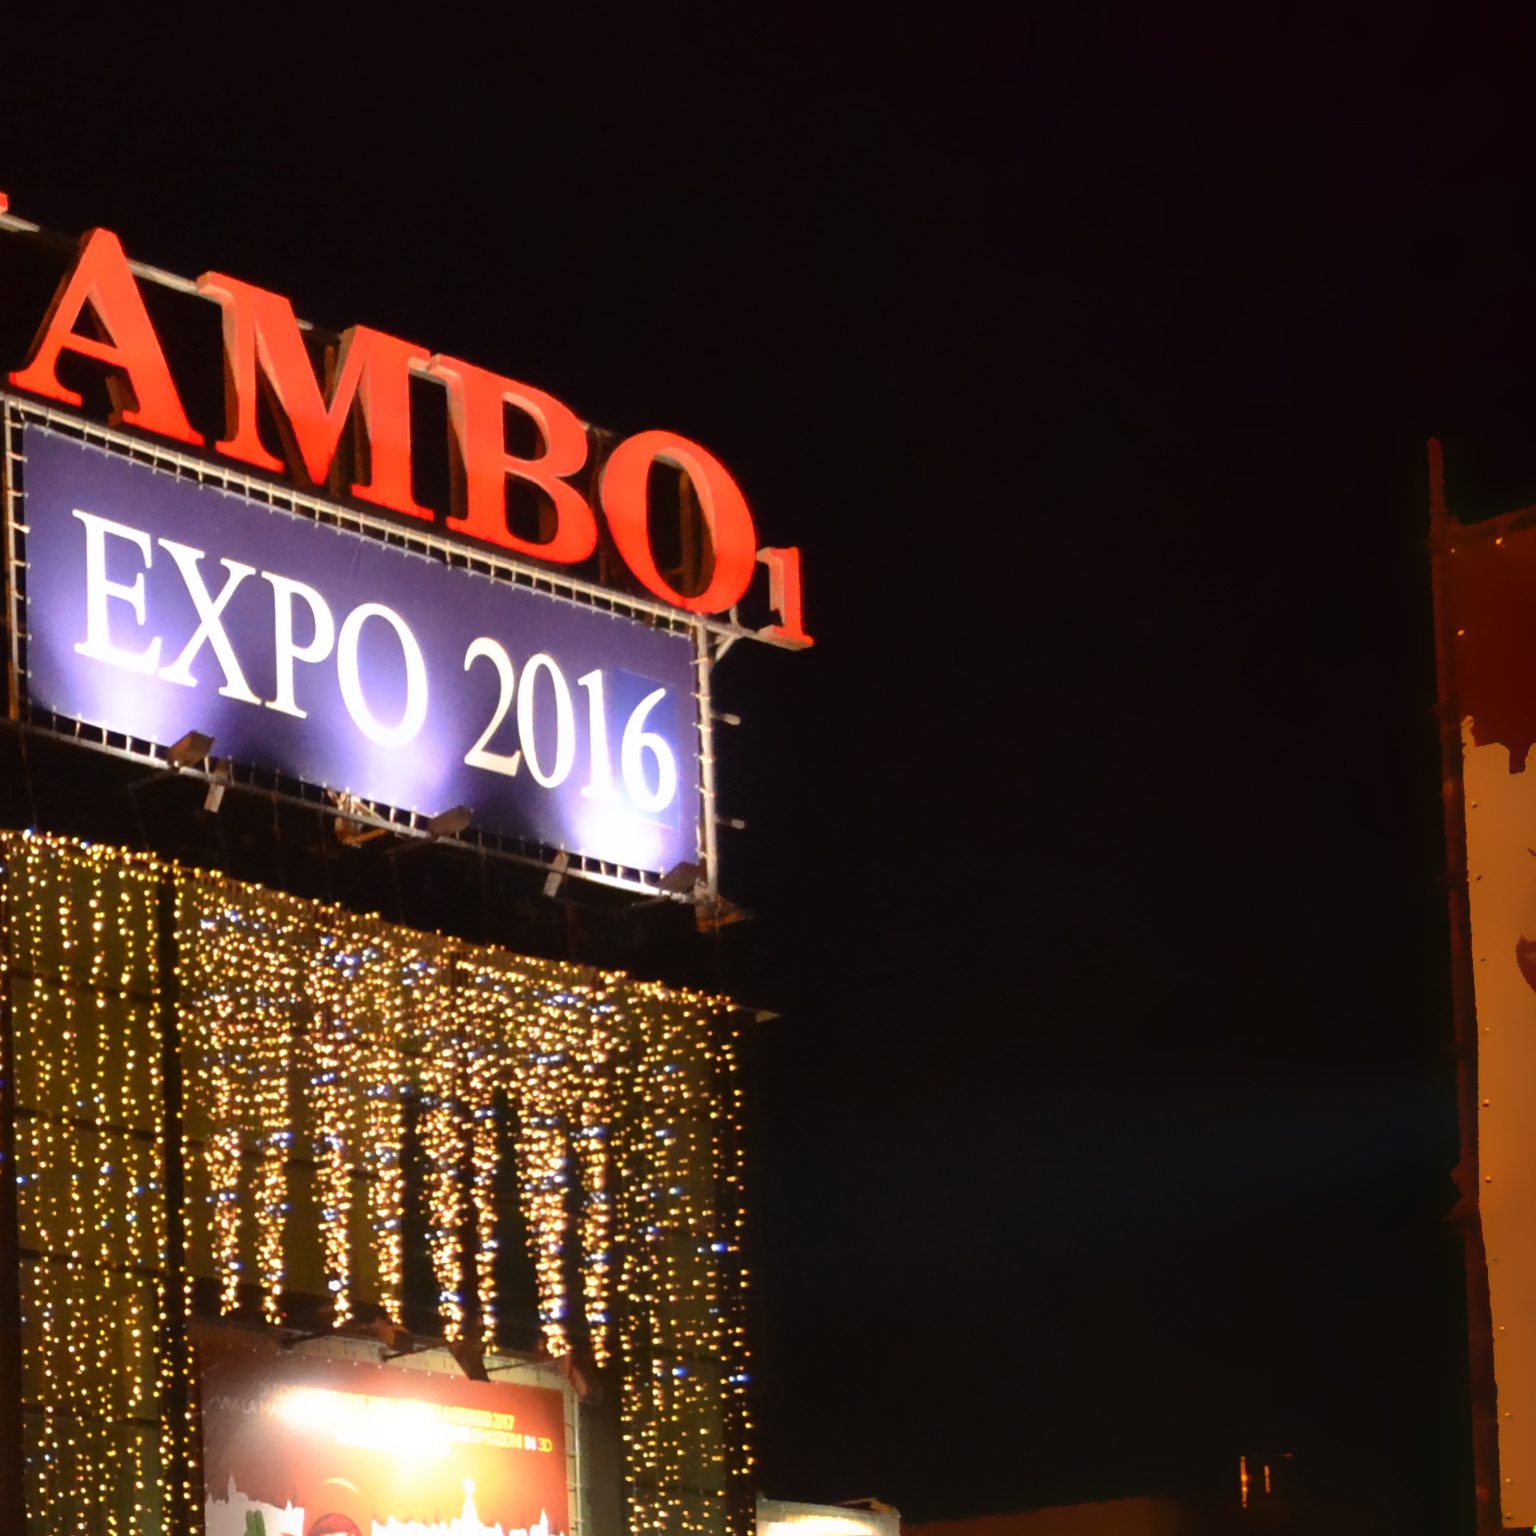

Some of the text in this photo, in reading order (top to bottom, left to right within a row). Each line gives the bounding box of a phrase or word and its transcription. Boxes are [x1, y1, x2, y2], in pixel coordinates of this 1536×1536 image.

[73, 509, 678, 812] EXPO 2016
[538, 1437, 553, 1452] 3D
